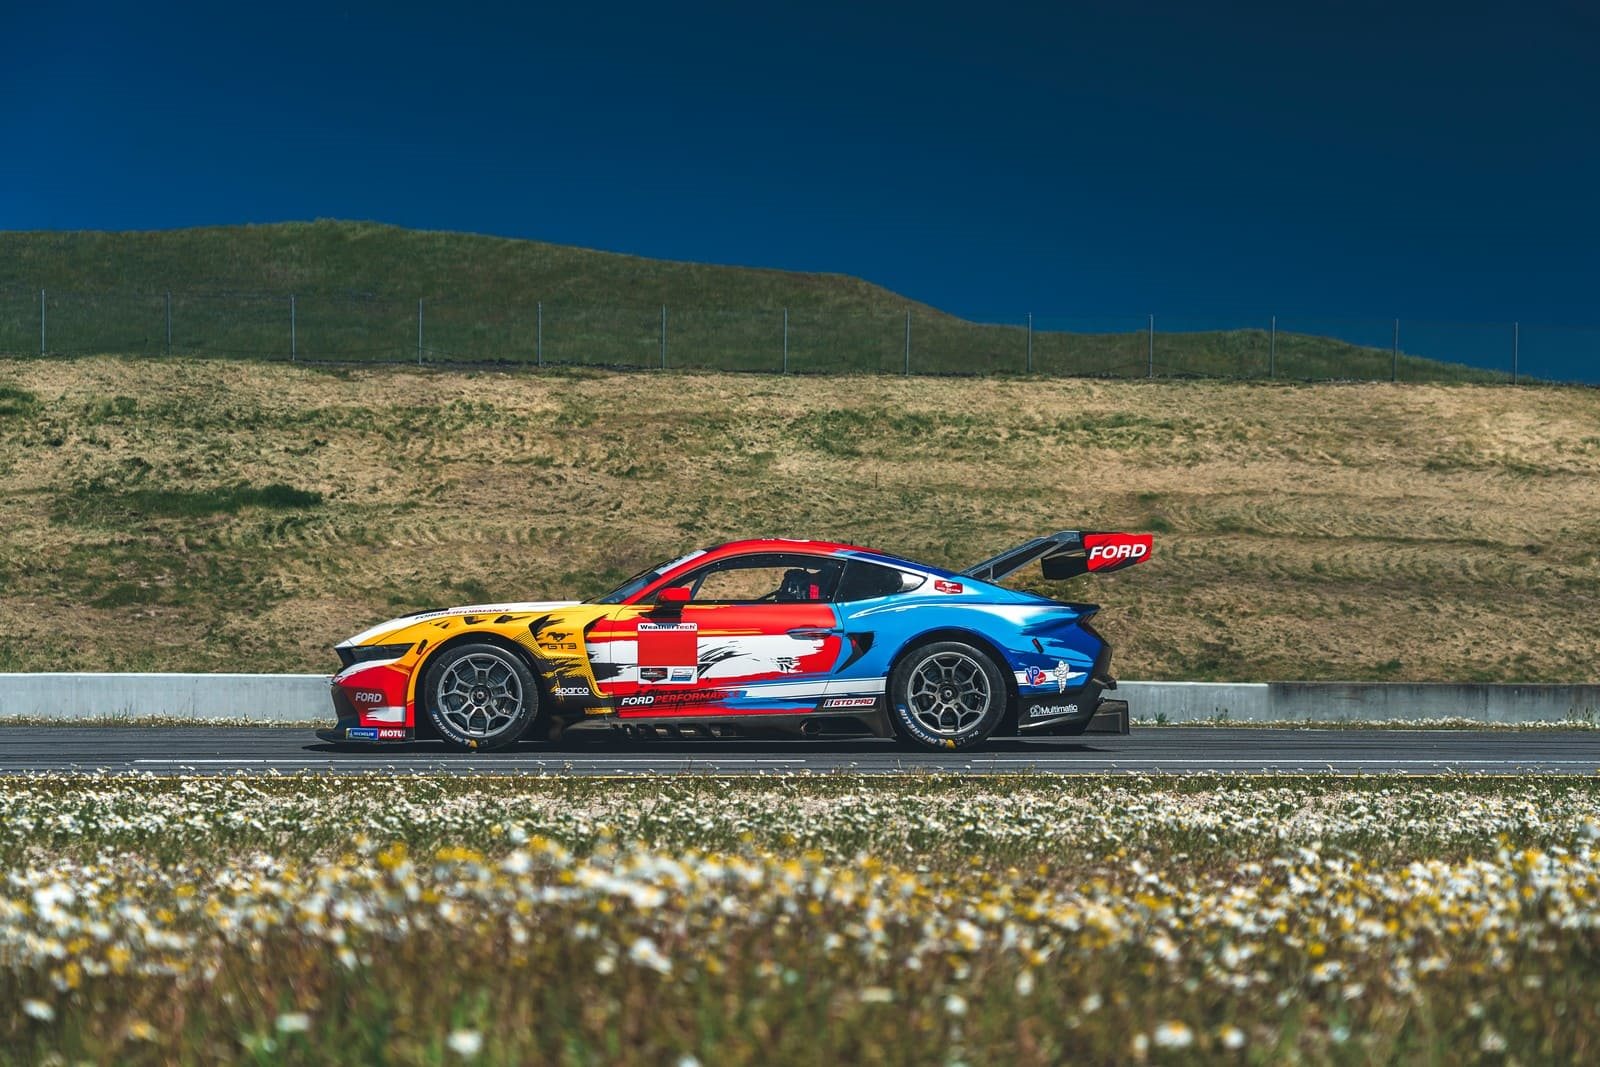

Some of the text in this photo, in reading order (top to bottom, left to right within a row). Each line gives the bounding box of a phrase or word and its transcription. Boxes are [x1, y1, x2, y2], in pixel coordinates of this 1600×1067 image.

[1090, 544, 1147, 560] FORD
[1026, 667, 1041, 686] VP
[355, 692, 383, 703] FORD
[621, 696, 654, 706] FORD
[1041, 705, 1078, 715] Multimatic
[432, 712, 464, 743] MICHELIN
[899, 708, 937, 744] MICHELIN
